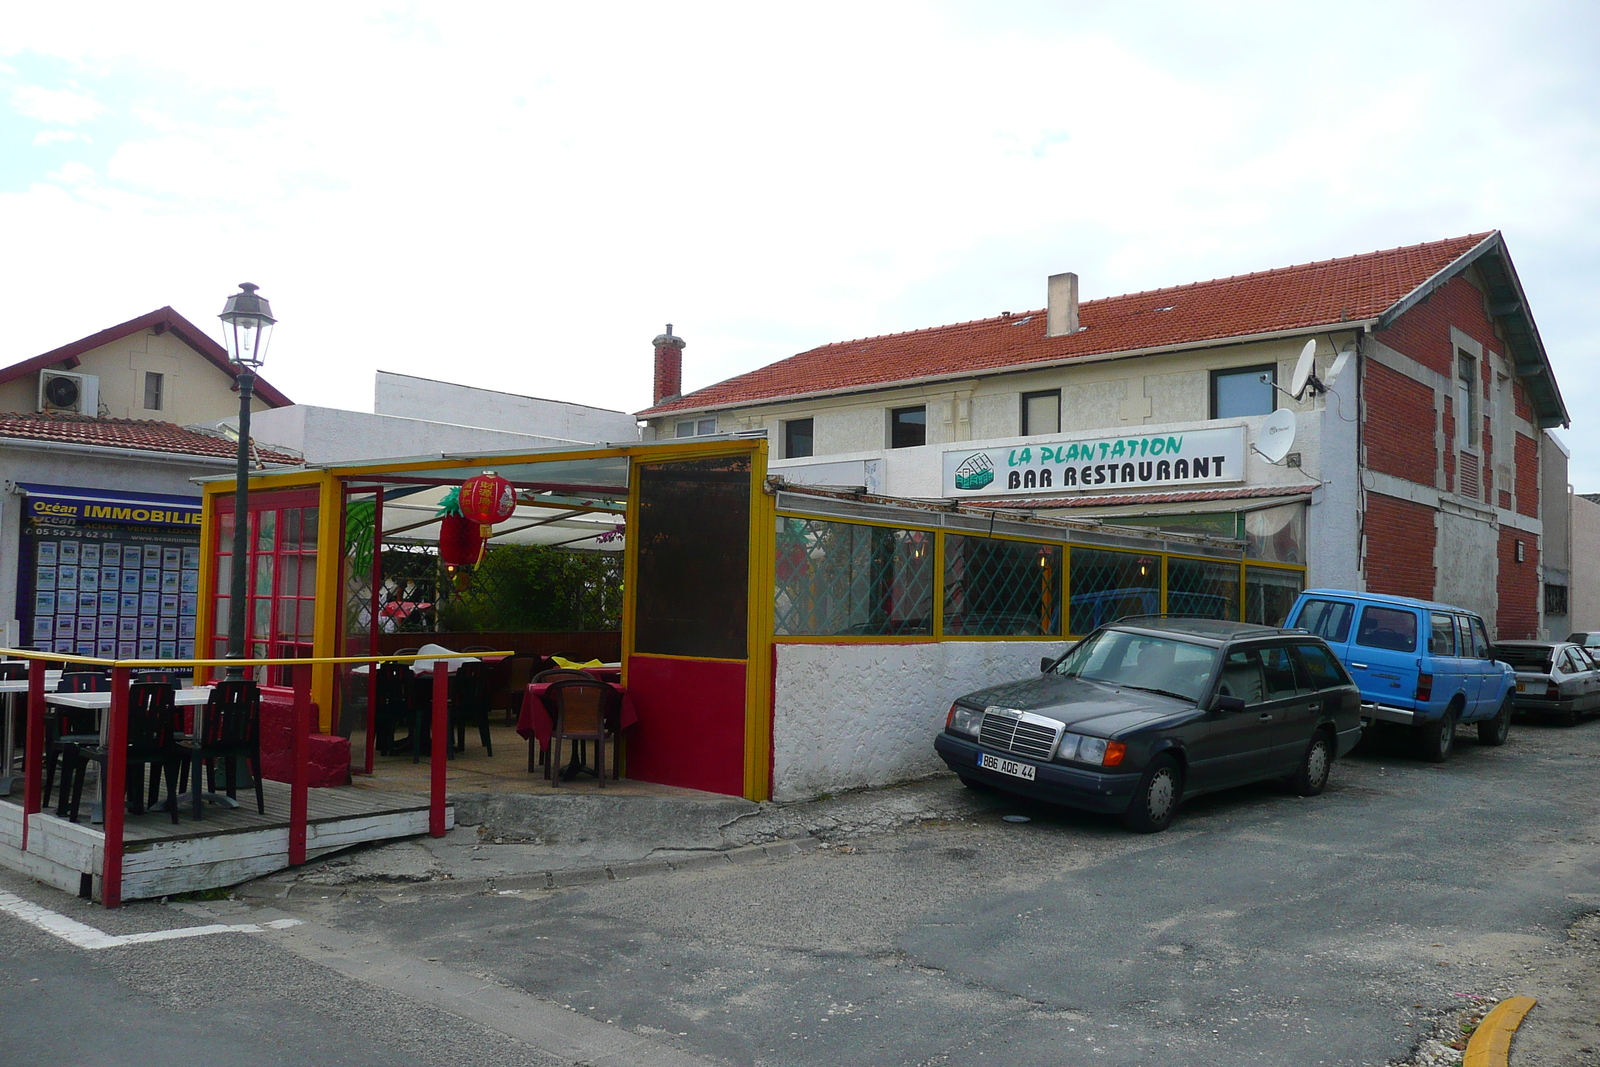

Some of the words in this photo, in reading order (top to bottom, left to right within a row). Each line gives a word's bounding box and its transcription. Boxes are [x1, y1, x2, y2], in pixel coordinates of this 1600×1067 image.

[1007, 447, 1033, 467] LA
[1040, 435, 1184, 466] PLANTATION
[1007, 467, 1053, 490] BAR
[1063, 456, 1225, 487] RESTAURANT
[33, 501, 78, 514] Océan
[35, 527, 50, 535] 05
[53, 529, 66, 537] 56
[69, 530, 83, 538] 73
[127, 525, 159, 533] VENTE
[1001, 760, 1019, 775] AQG
[1021, 765, 1033, 779] 44
